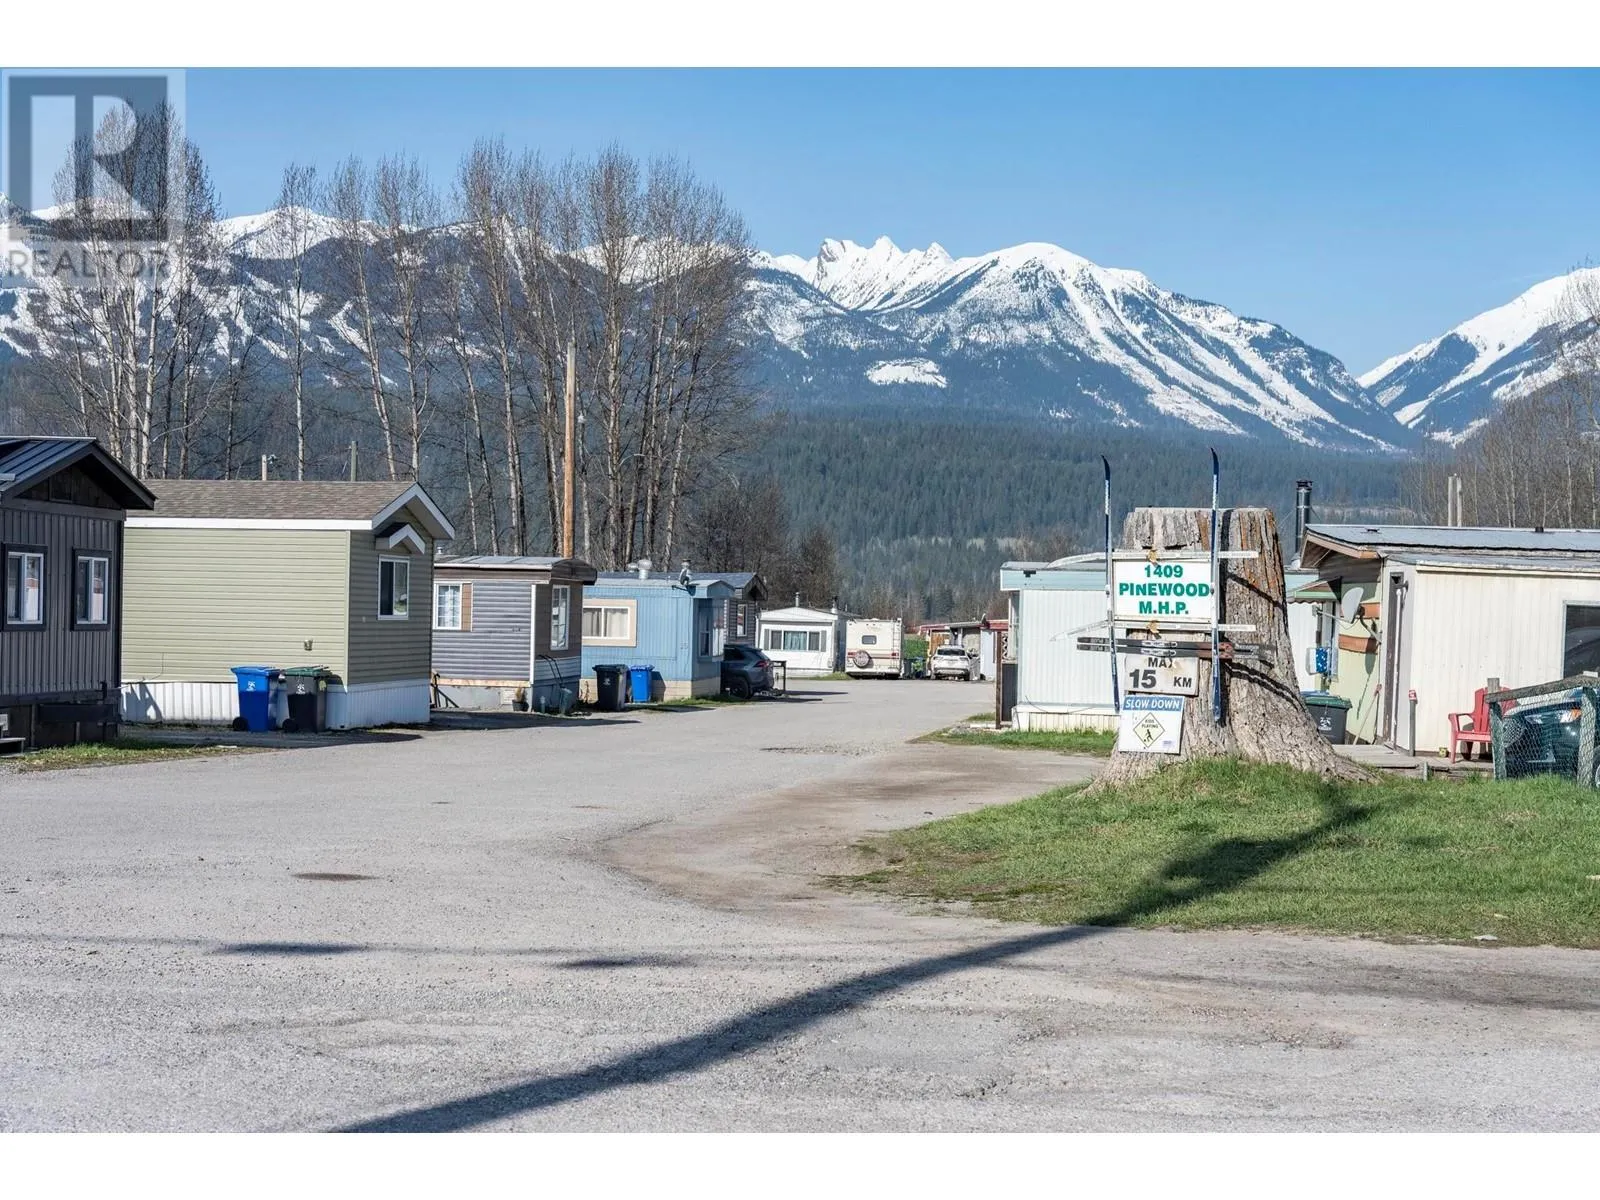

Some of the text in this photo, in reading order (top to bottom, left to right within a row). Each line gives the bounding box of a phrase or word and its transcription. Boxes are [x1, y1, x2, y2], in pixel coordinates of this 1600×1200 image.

[1144, 564, 1184, 578] 1409
[1119, 582, 1210, 597] PINEWOOD
[1138, 600, 1189, 615] M.H.P.
[1147, 656, 1174, 669] MAX
[1129, 668, 1192, 689] 15 KM
[1124, 699, 1180, 710] SLOW DOWN
